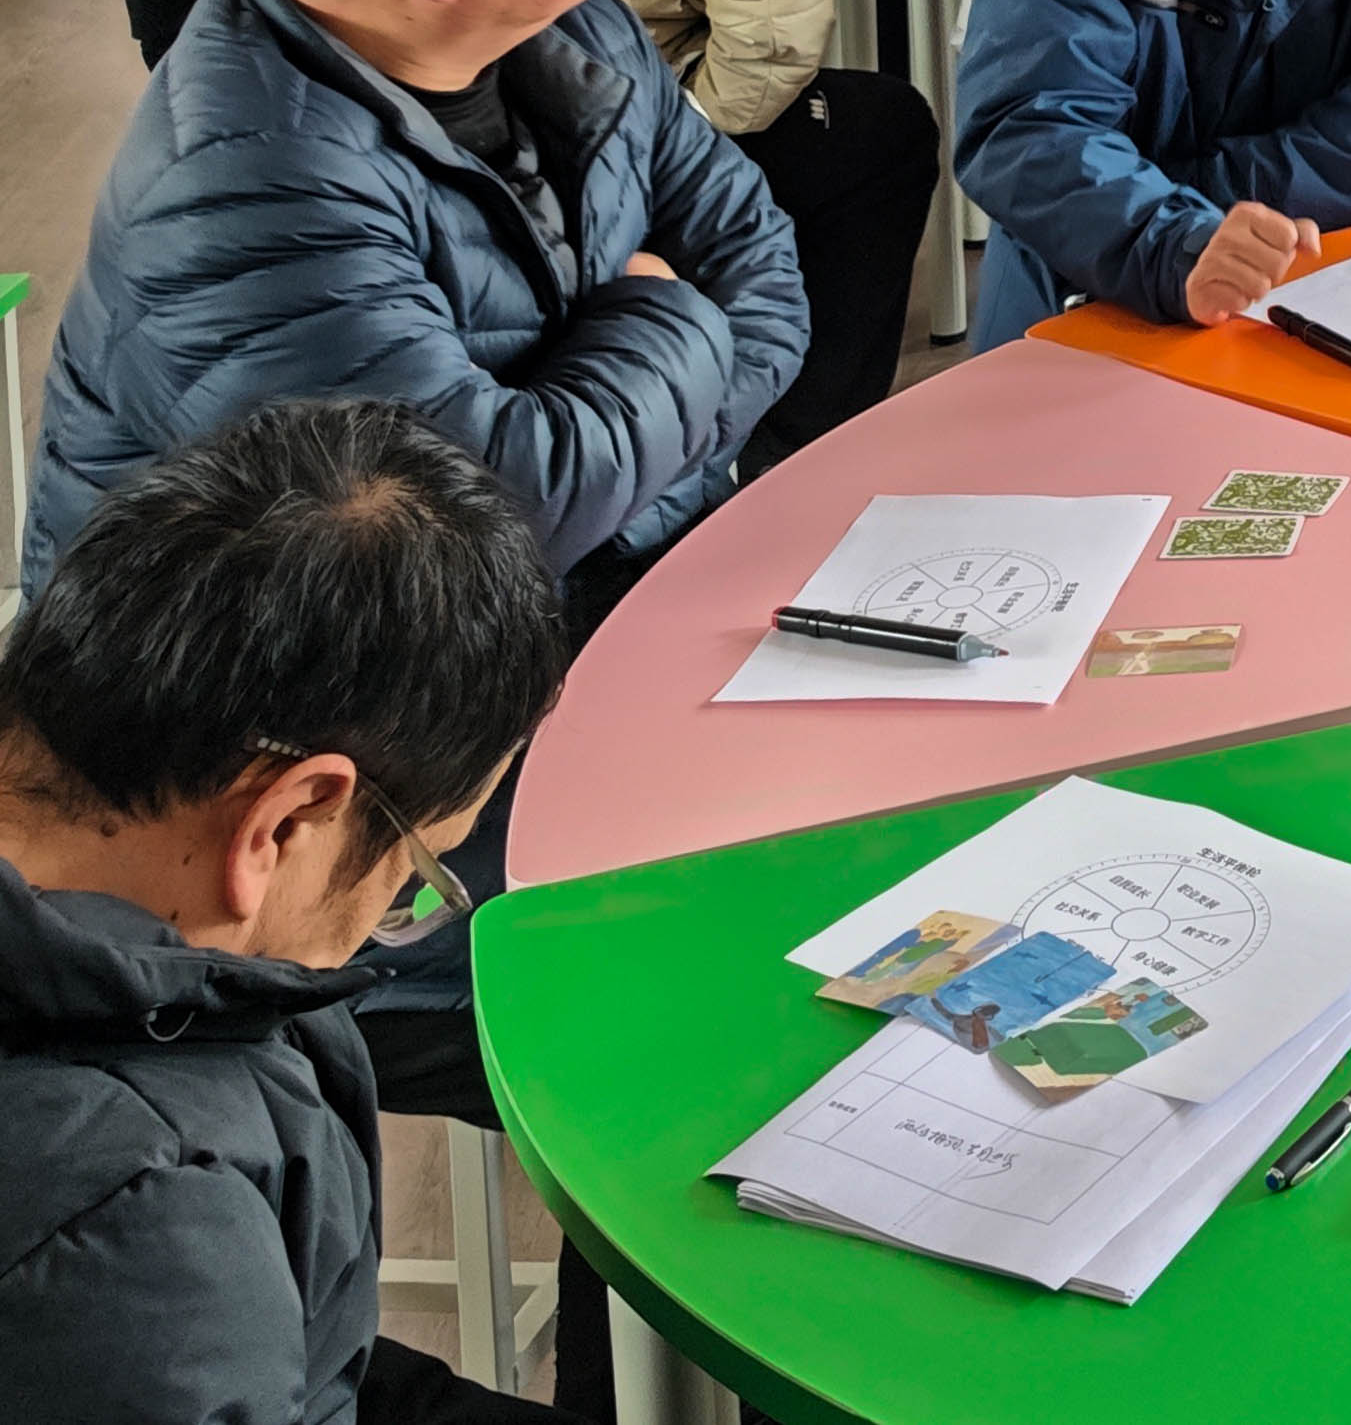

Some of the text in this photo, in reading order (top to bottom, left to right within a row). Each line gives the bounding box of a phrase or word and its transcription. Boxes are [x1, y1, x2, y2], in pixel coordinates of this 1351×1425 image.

[1196, 847, 1262, 878] 生活平衡轮
